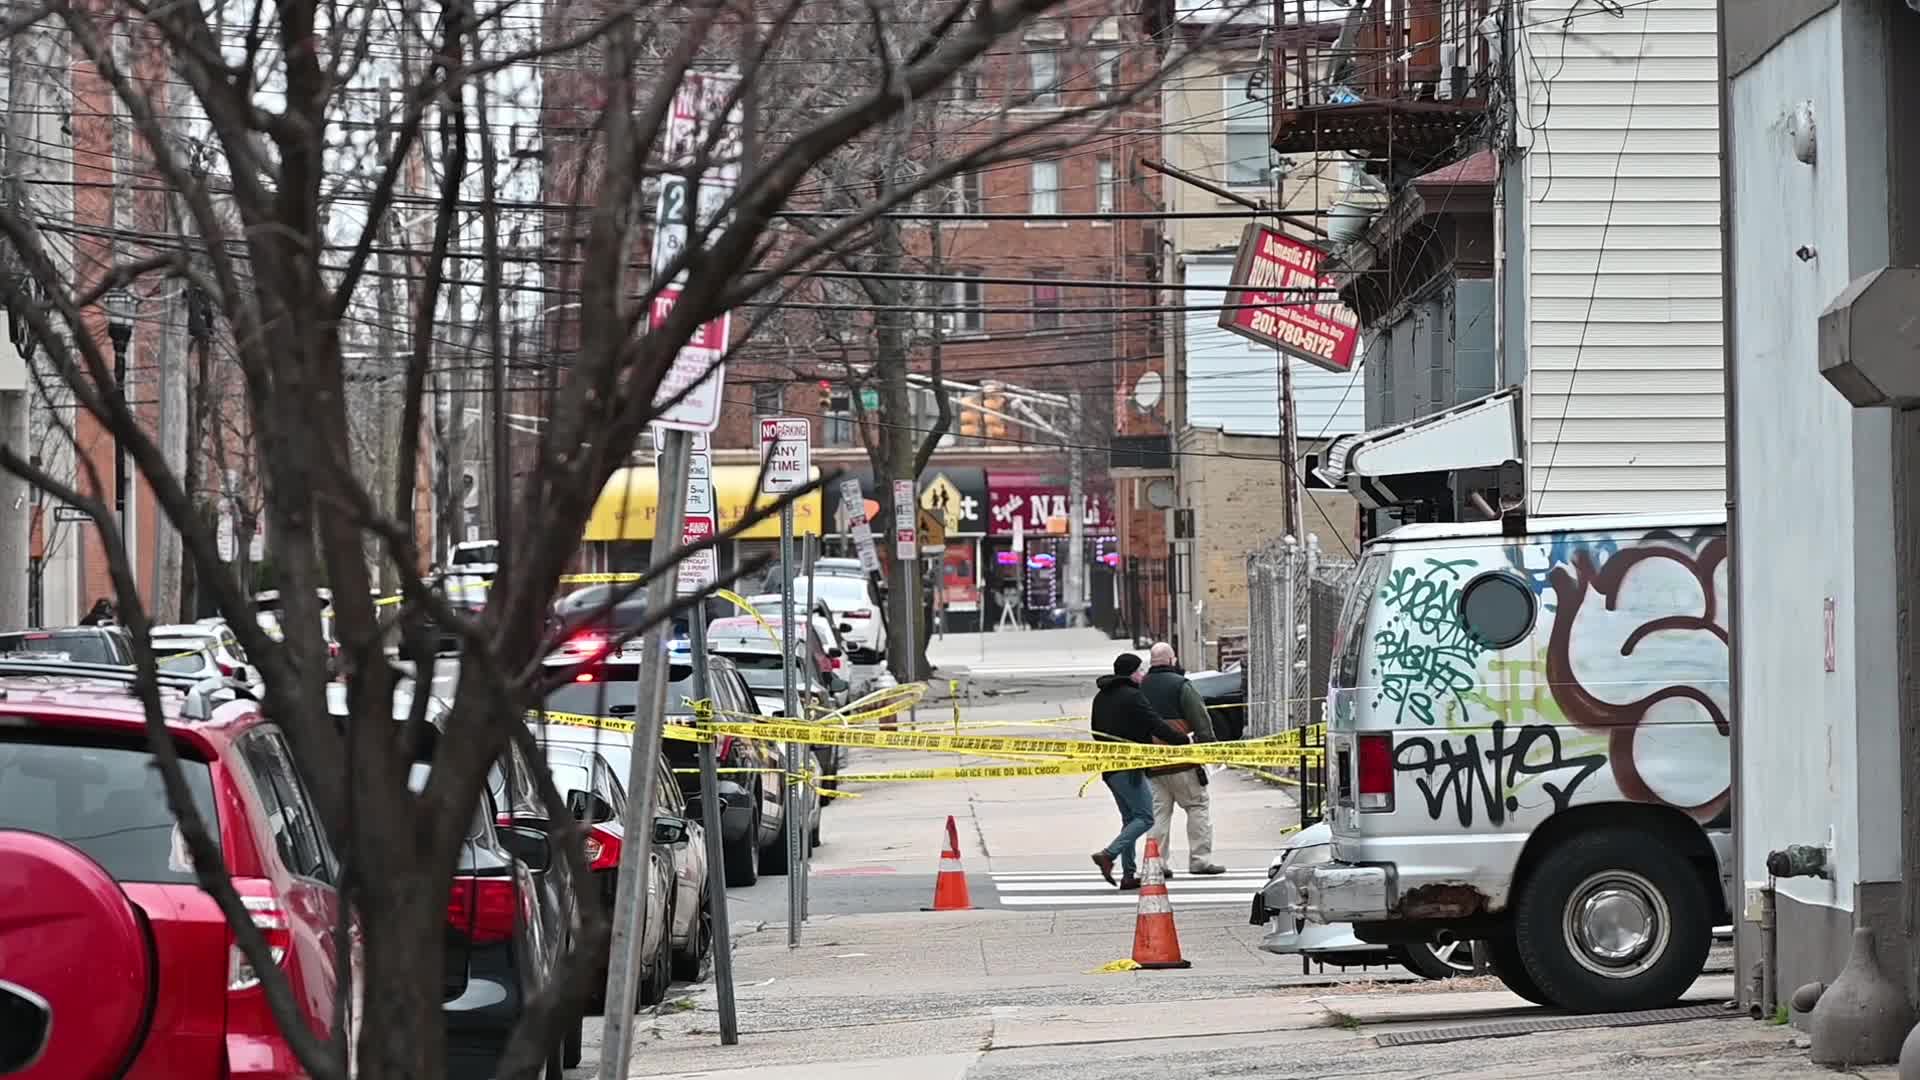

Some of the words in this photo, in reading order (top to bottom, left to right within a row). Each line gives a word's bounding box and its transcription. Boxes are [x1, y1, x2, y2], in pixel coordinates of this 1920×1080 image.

[763, 424, 776, 437] NO
[777, 425, 806, 436] PARKING
[772, 447, 797, 457] ANY
[770, 461, 800, 471] TIME
